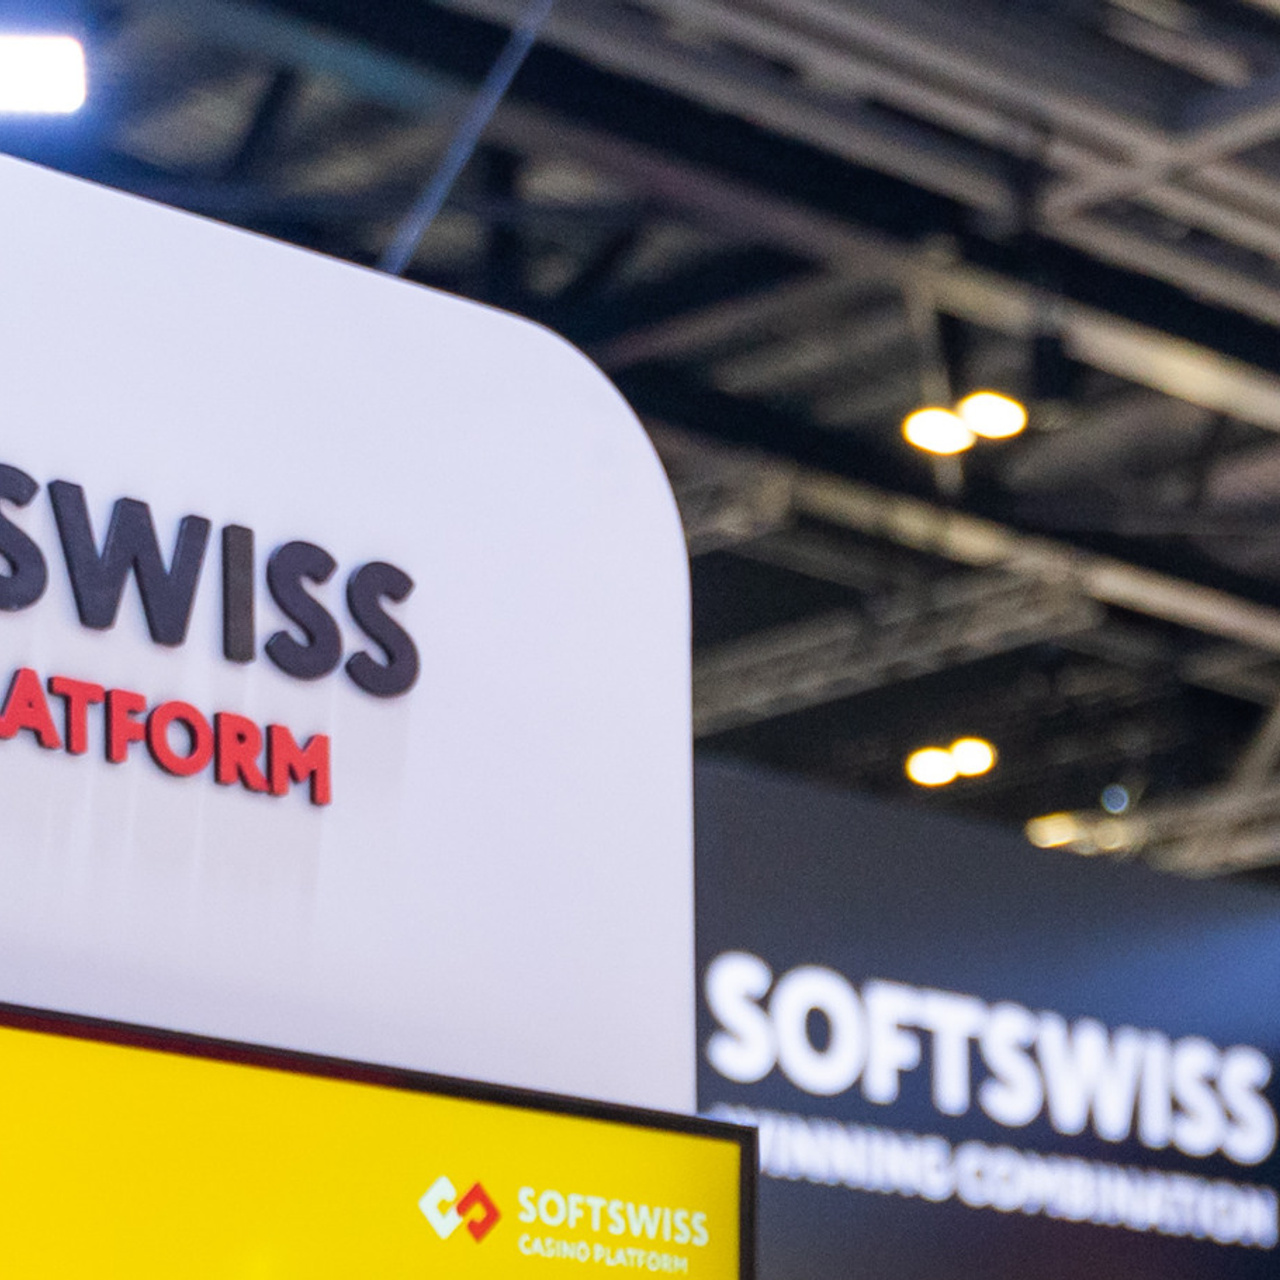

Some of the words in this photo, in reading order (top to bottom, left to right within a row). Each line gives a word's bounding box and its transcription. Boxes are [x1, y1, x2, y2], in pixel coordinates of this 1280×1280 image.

[705, 950, 1279, 1165] SOFTSWISS
[517, 1186, 709, 1247] SOFTSWISS
[517, 1234, 590, 1263] CASINO
[593, 1243, 689, 1274] PLATFORM
